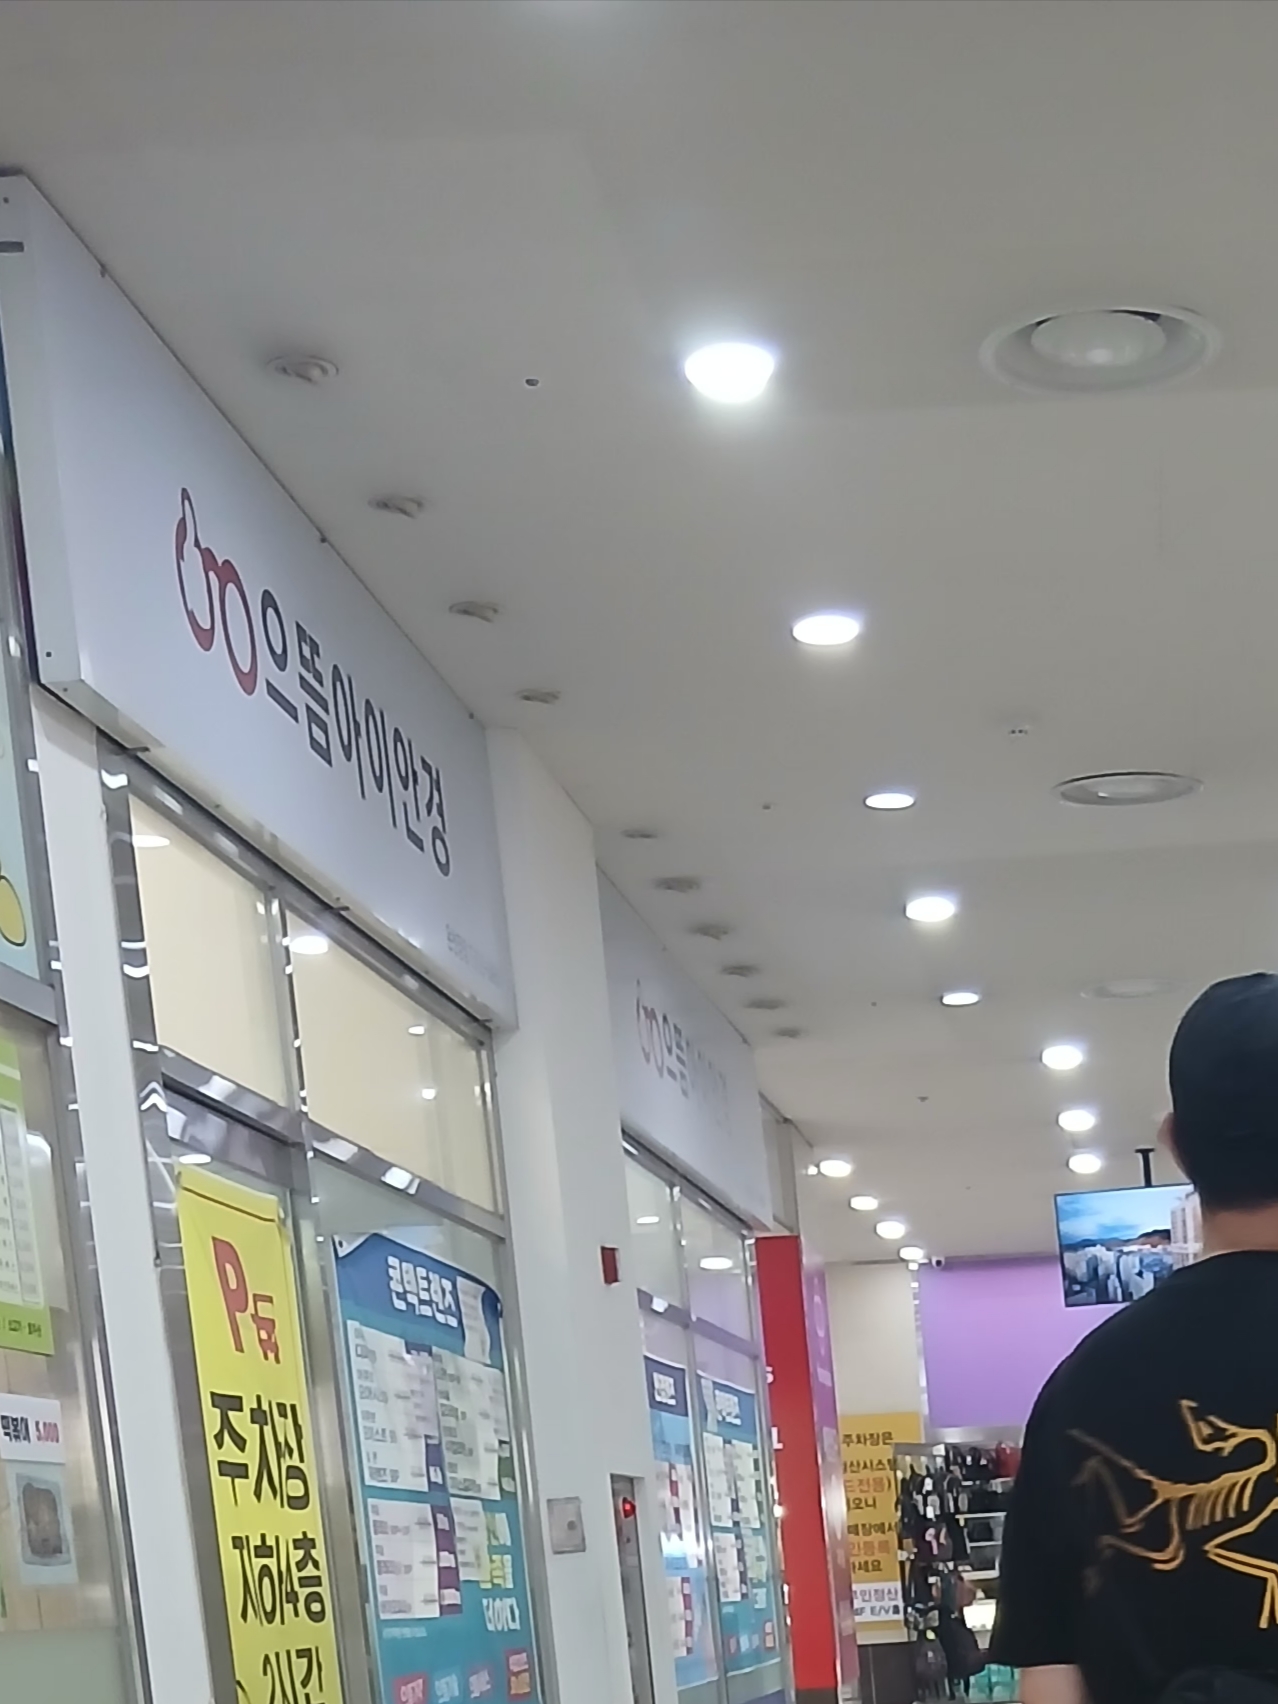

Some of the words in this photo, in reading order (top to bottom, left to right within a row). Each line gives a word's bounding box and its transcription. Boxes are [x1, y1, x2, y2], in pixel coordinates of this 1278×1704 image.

[261, 589, 451, 877] 으뜸아이안경
[211, 1235, 249, 1354] P
[209, 1391, 310, 1511] 주차장
[842, 1430, 893, 1448] 주차장은
[847, 1495, 877, 1512] 오니
[231, 1531, 327, 1627] 지하4층
